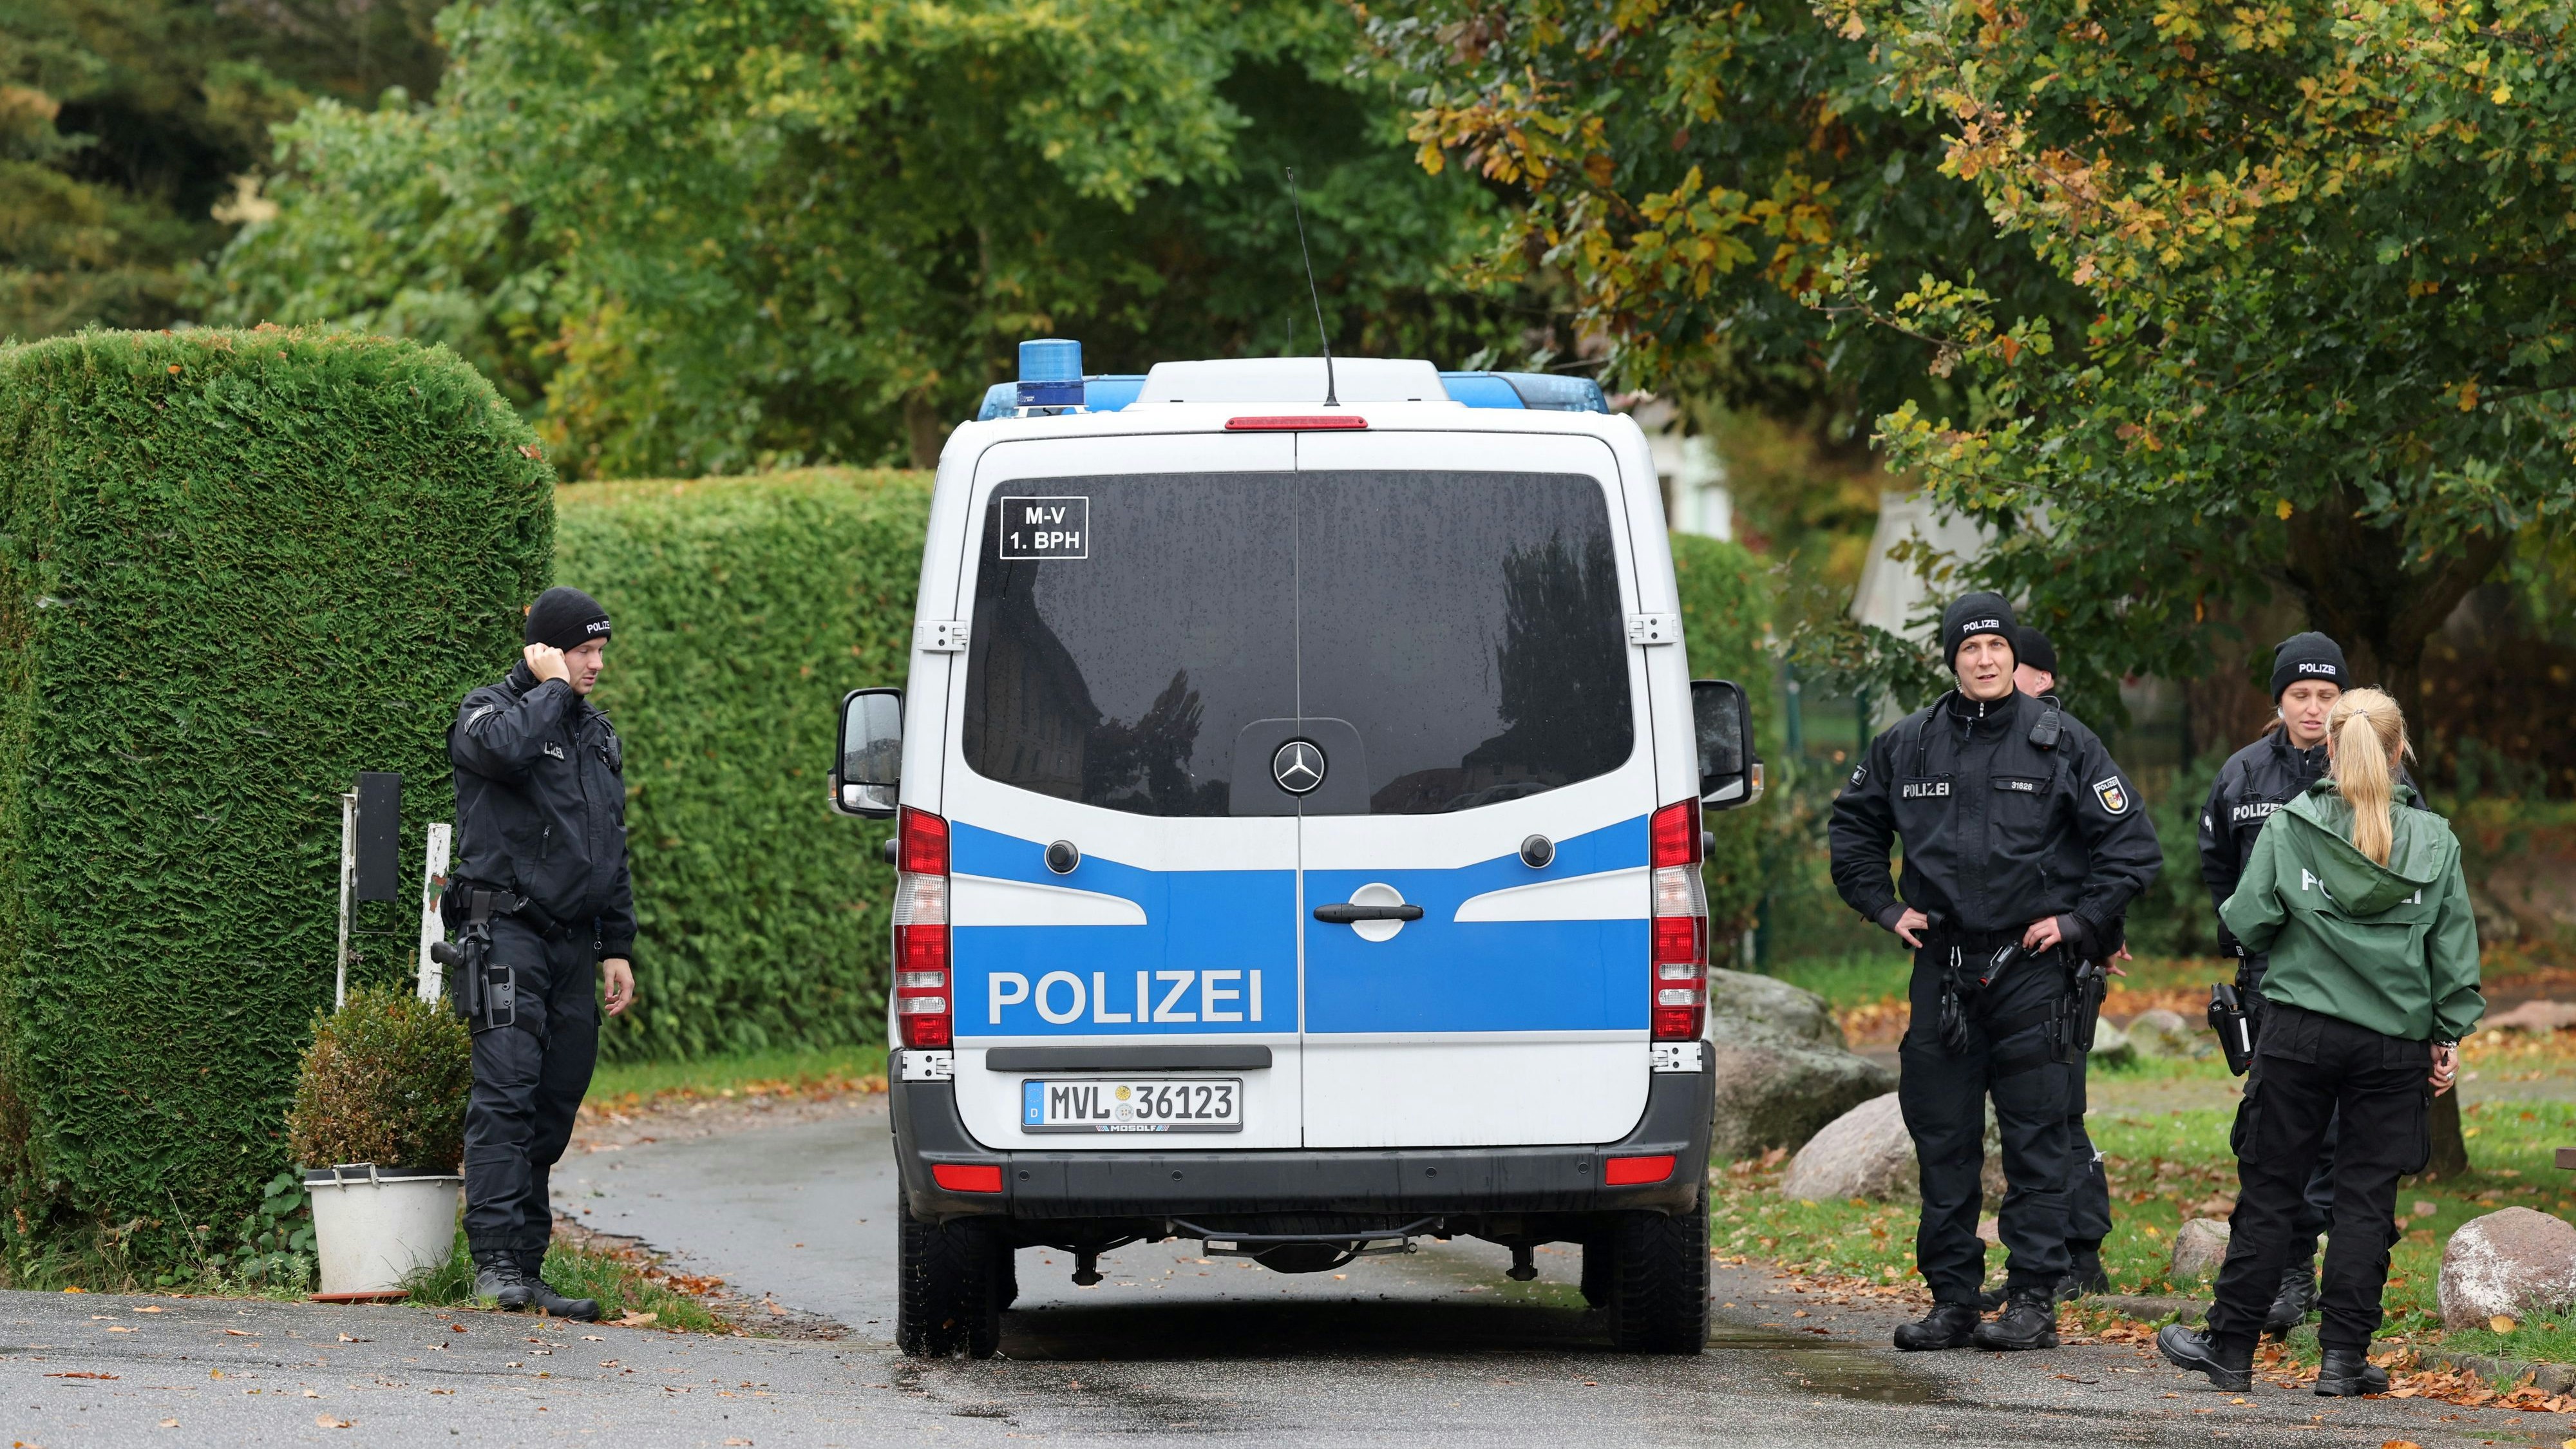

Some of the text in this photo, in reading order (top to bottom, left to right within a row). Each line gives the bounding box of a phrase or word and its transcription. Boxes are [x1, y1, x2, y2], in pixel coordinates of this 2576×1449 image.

[1026, 507, 1066, 524] M-V
[1010, 531, 1079, 549] 1. BPH
[587, 621, 610, 634] POLIZE
[1963, 620, 1999, 633] POLIZEI
[2299, 663, 2335, 675] POLIZEI
[1903, 782, 1949, 797] POLIZEI
[2097, 779, 2117, 792] POLIZEI
[2233, 803, 2283, 821] POLIZE
[989, 970, 1262, 1024] POLIZEI
[1052, 1086, 1232, 1119] MVL 36123
[1030, 1108, 1038, 1117] D
